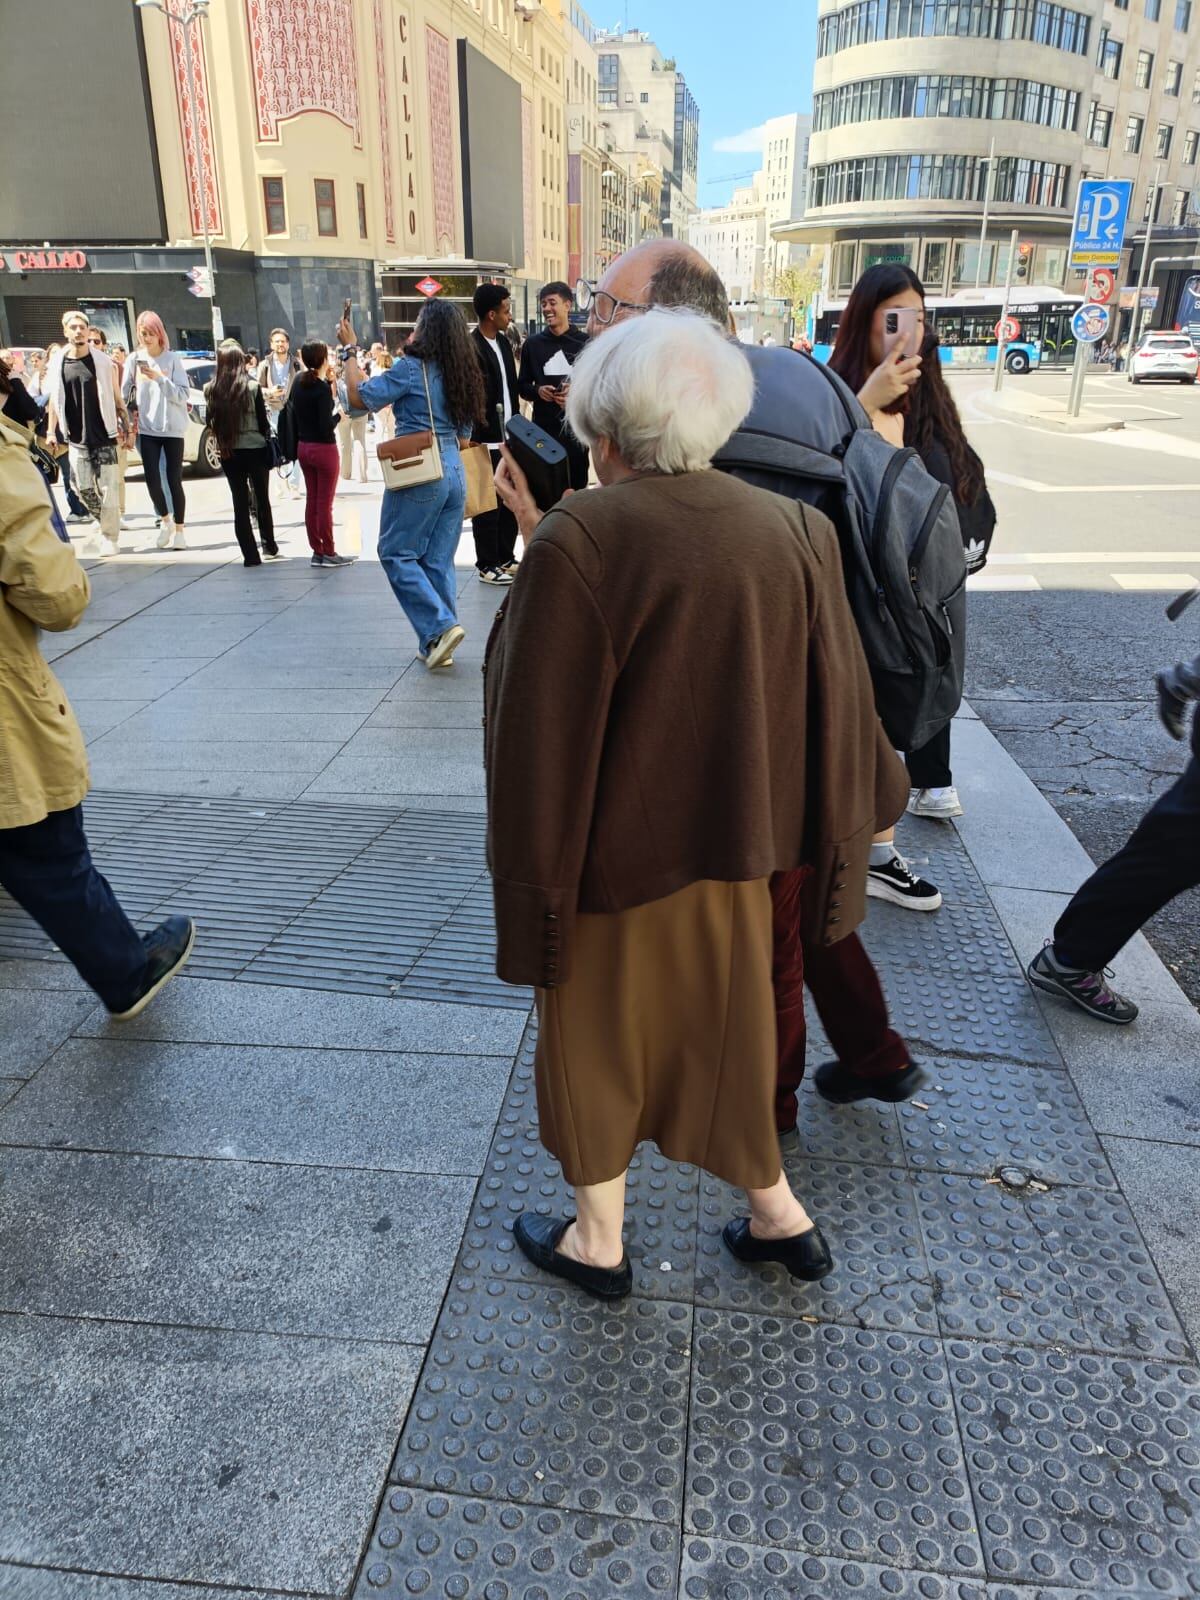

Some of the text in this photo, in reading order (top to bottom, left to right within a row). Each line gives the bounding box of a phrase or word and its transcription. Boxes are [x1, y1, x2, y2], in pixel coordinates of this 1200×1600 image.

[399, 15, 416, 235] CALLAO
[1085, 193, 1120, 240] P
[1102, 241, 1111, 249] 24
[15, 251, 86, 269] CALLAO
[1018, 304, 1039, 313] MADRID
